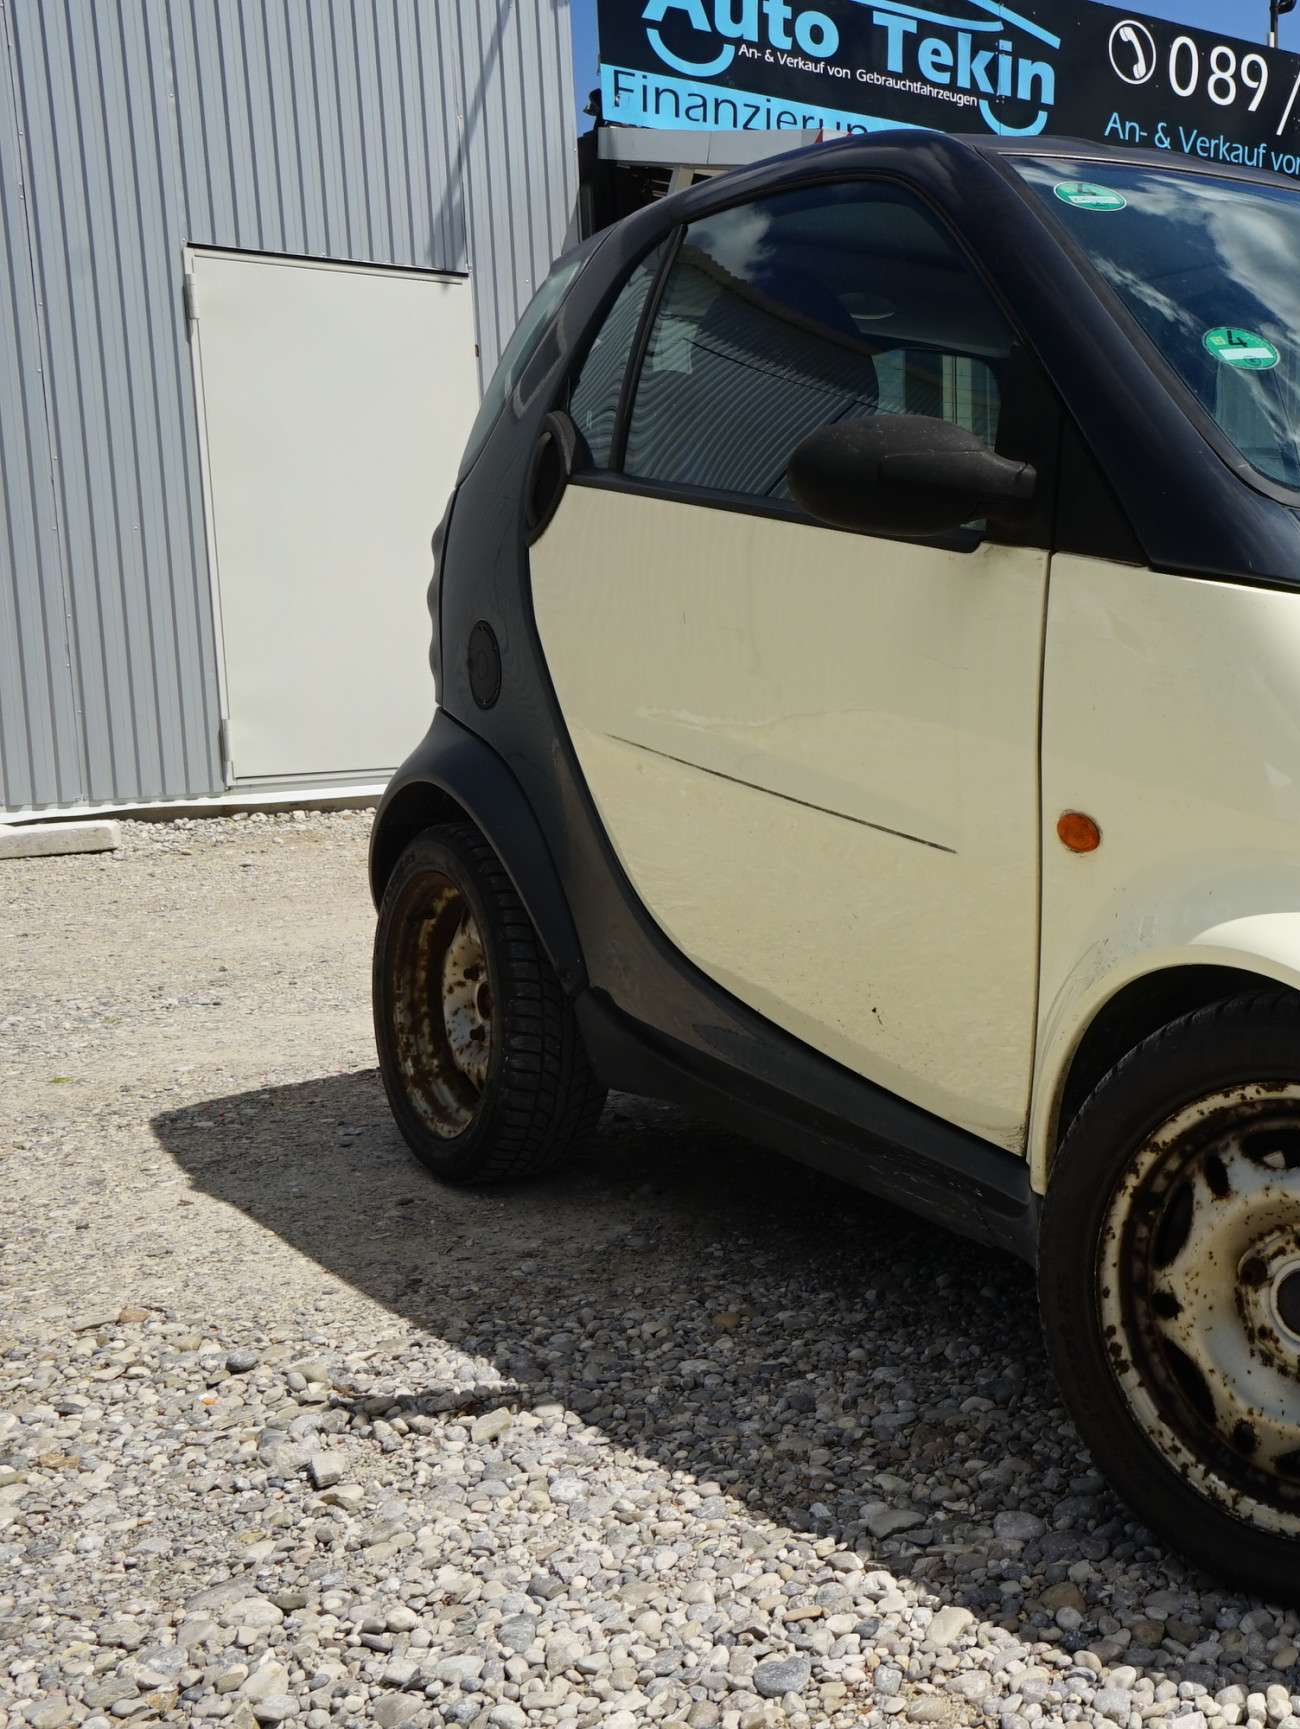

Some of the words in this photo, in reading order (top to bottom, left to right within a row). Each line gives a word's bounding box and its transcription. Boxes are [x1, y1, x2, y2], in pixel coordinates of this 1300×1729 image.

[738, 44, 762, 59] An-
[764, 50, 775, 62] &
[777, 52, 825, 74] Verkauf
[828, 65, 851, 79] von
[856, 68, 978, 107] Gebrauchtfahrzeugen
[873, 10, 1056, 105] Tekin
[1168, 35, 1269, 112] 089
[1104, 112, 1148, 142] An-
[1154, 122, 1171, 149] &
[1178, 126, 1267, 168] Verkauf
[1226, 330, 1248, 348] 4
